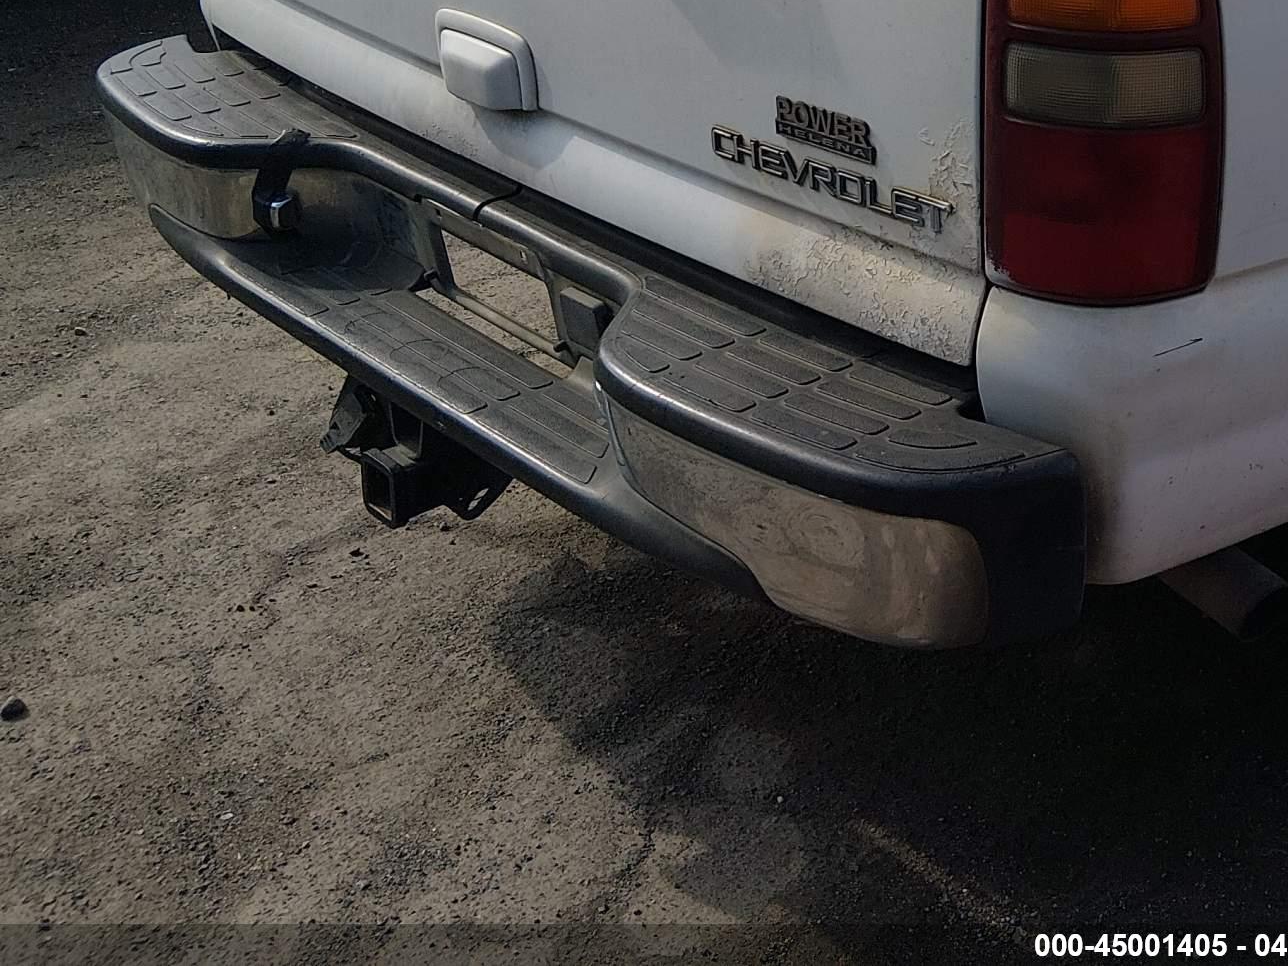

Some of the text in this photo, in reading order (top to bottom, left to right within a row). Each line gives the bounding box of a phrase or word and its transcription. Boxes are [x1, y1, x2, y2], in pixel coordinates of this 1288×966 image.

[776, 95, 871, 147] POWER
[778, 122, 869, 160] HELENA
[710, 124, 955, 233] CHEVROLET
